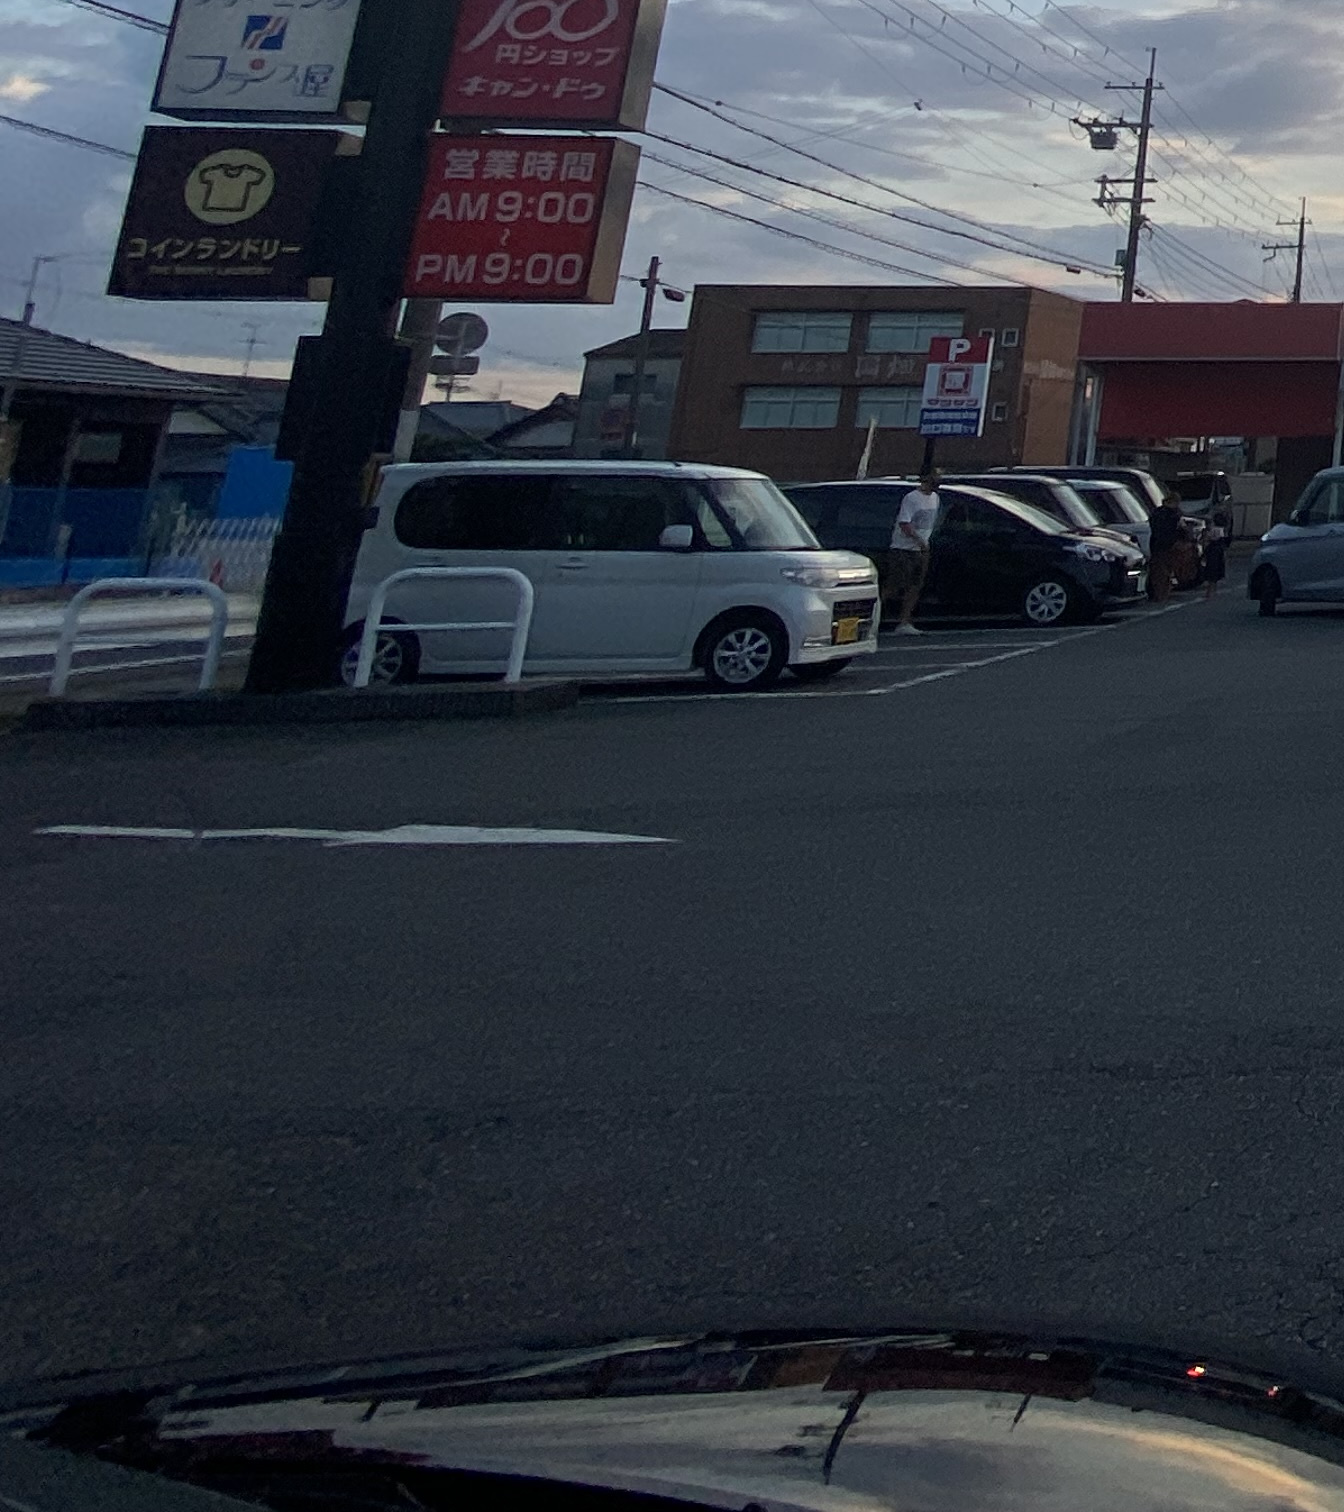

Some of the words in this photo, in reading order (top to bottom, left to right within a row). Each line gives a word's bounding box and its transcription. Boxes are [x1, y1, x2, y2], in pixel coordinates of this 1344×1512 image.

[495, 44, 621, 67] 円ショップ
[444, 148, 597, 182] 営業時間
[127, 236, 302, 261] コインランドリー
[948, 338, 972, 363] P
